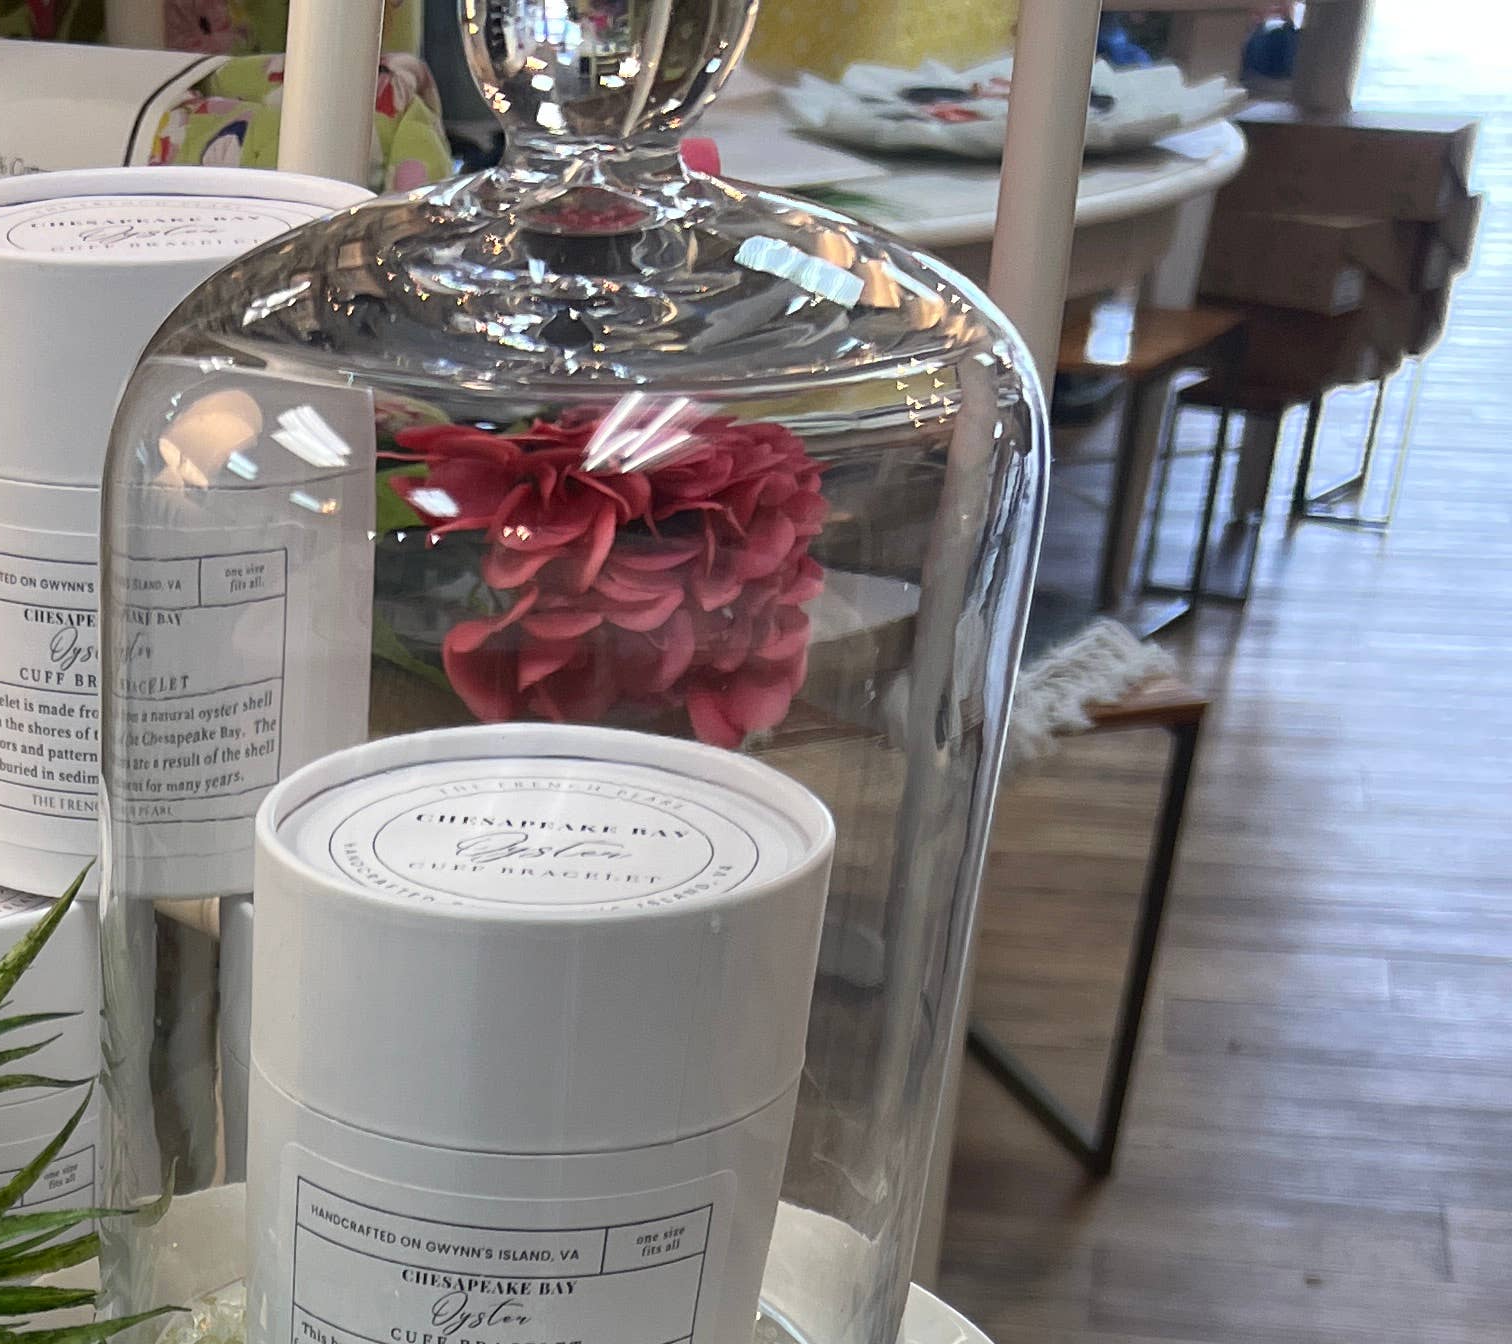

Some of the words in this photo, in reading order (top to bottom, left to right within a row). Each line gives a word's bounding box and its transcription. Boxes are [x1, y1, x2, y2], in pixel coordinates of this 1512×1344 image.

[20, 576, 37, 587] ON
[40, 578, 95, 593] GWYNN'S
[19, 667, 65, 685] CUFF
[23, 699, 34, 712] is
[38, 704, 75, 718] made
[242, 690, 273, 712] shell
[5, 717, 25, 733] the
[28, 721, 72, 739] shores
[75, 727, 93, 740] of
[254, 718, 276, 734] The
[416, 814, 617, 833] CHESAPEAKE
[632, 827, 689, 838] BAY
[456, 832, 633, 863] Oyster
[311, 1204, 396, 1244] HANDCRAFTED
[400, 1236, 421, 1250] ON
[425, 1240, 493, 1259] GWYNN'S
[498, 1249, 554, 1262] ISLAND,
[560, 1249, 579, 1261] VA
[636, 1234, 658, 1245] one
[663, 1226, 685, 1240] size
[641, 1245, 661, 1257] fits
[665, 1239, 680, 1251] all
[402, 1269, 532, 1296] CHESAPEAKE
[539, 1280, 576, 1295] BAY
[431, 1291, 531, 1335] Oyster
